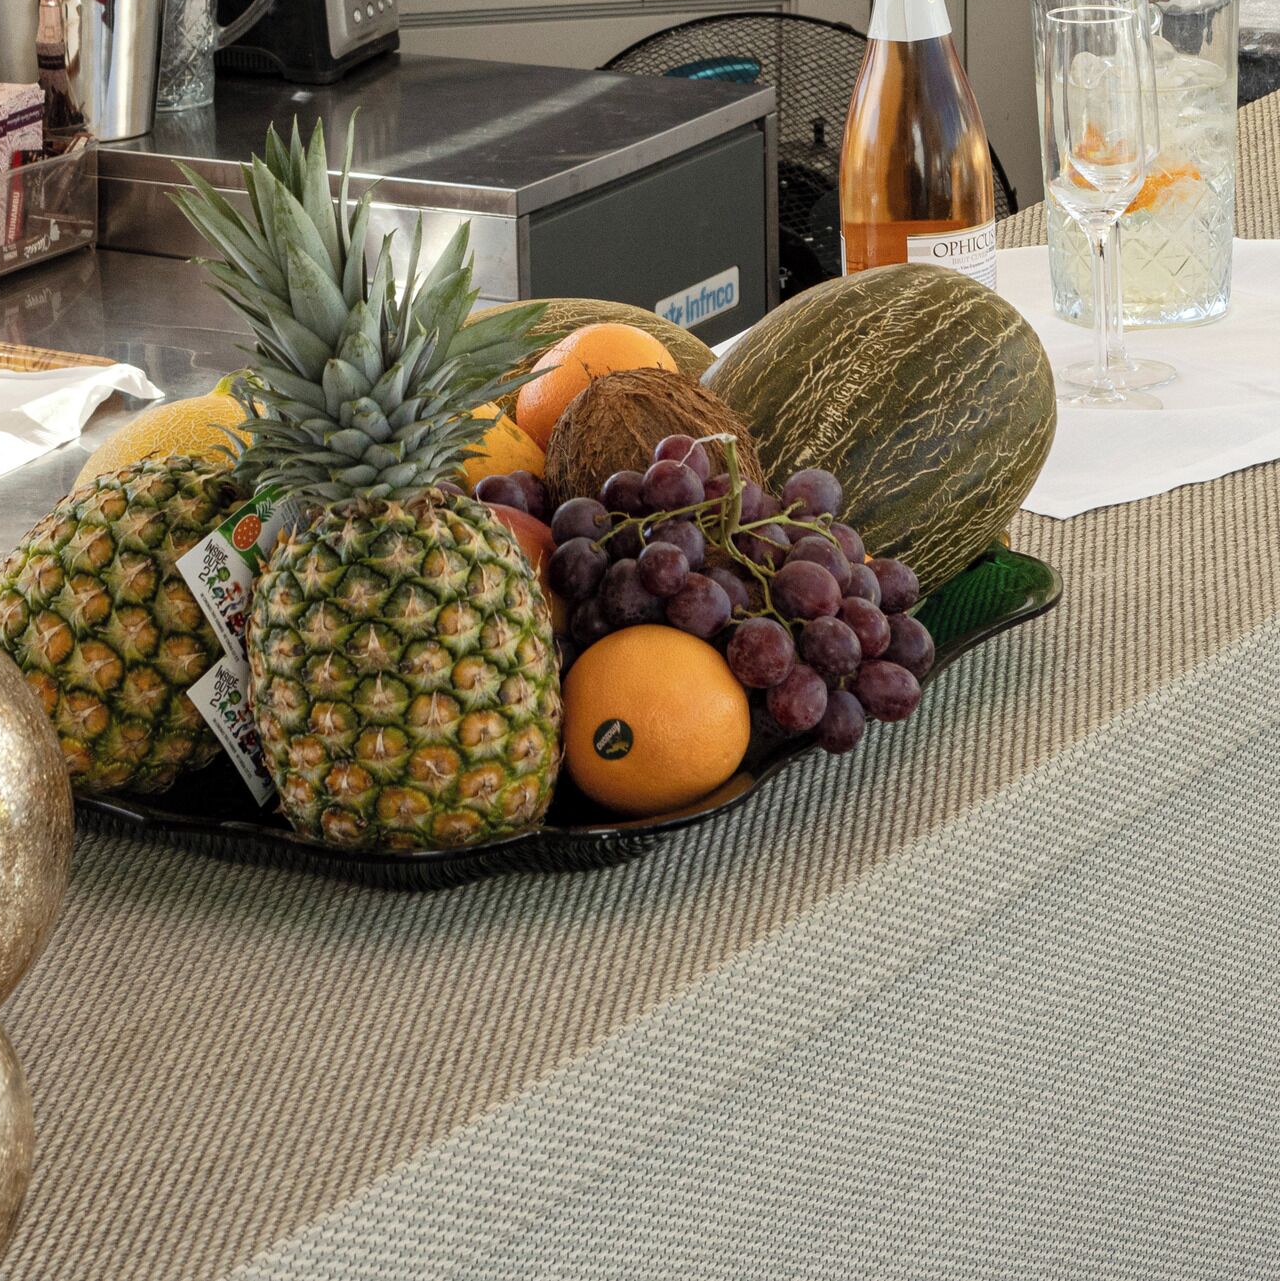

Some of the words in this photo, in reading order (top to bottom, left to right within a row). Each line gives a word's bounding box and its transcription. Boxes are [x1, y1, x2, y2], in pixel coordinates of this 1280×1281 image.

[685, 282, 734, 324] Infrico
[204, 538, 229, 566] INSIDE
[203, 554, 220, 573] OUT
[198, 566, 210, 582] 2
[215, 665, 239, 689] INSIDE
[214, 680, 231, 697] OUT
[210, 692, 222, 708] 2
